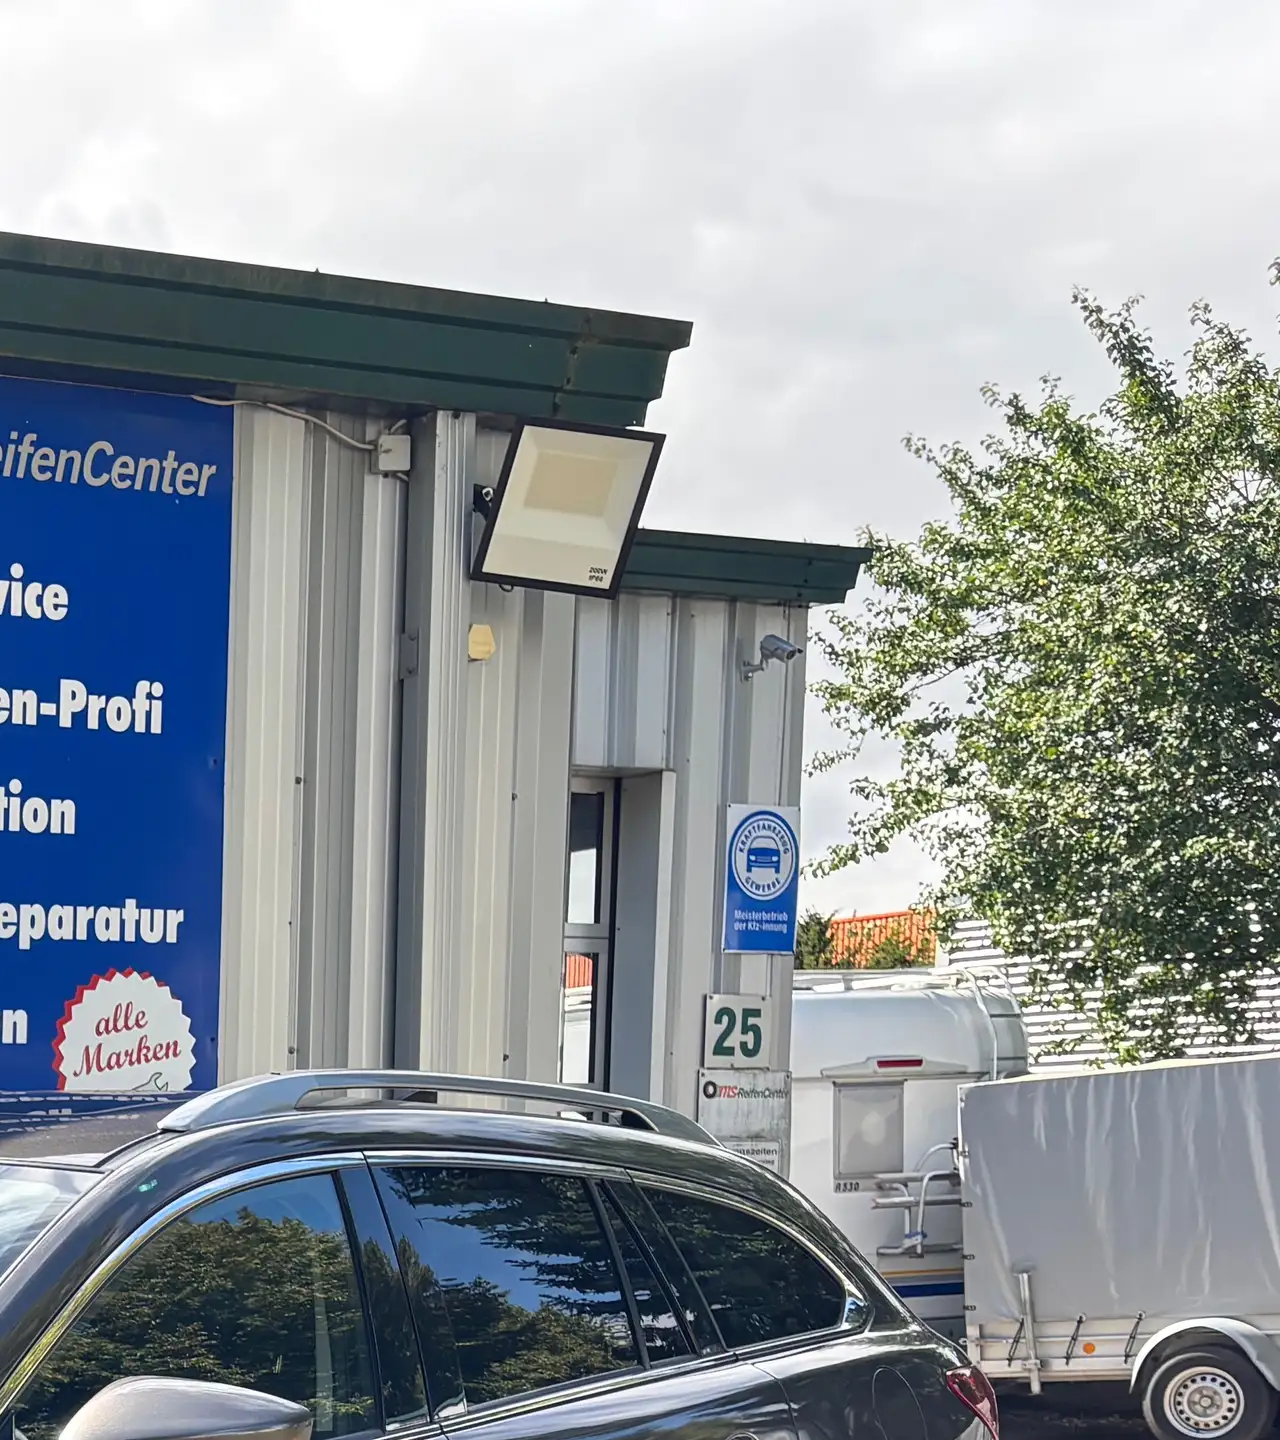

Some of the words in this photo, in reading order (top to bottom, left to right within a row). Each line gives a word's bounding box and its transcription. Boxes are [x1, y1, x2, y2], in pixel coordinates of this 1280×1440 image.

[738, 822, 790, 855] KRAFTFAHRZEUG
[744, 875, 782, 893] GEWERBE
[733, 921, 747, 931] der
[734, 909, 789, 922] Meisterbetrieb
[94, 1000, 149, 1038] alle
[712, 1006, 763, 1059] 25
[72, 1036, 182, 1078] Marken
